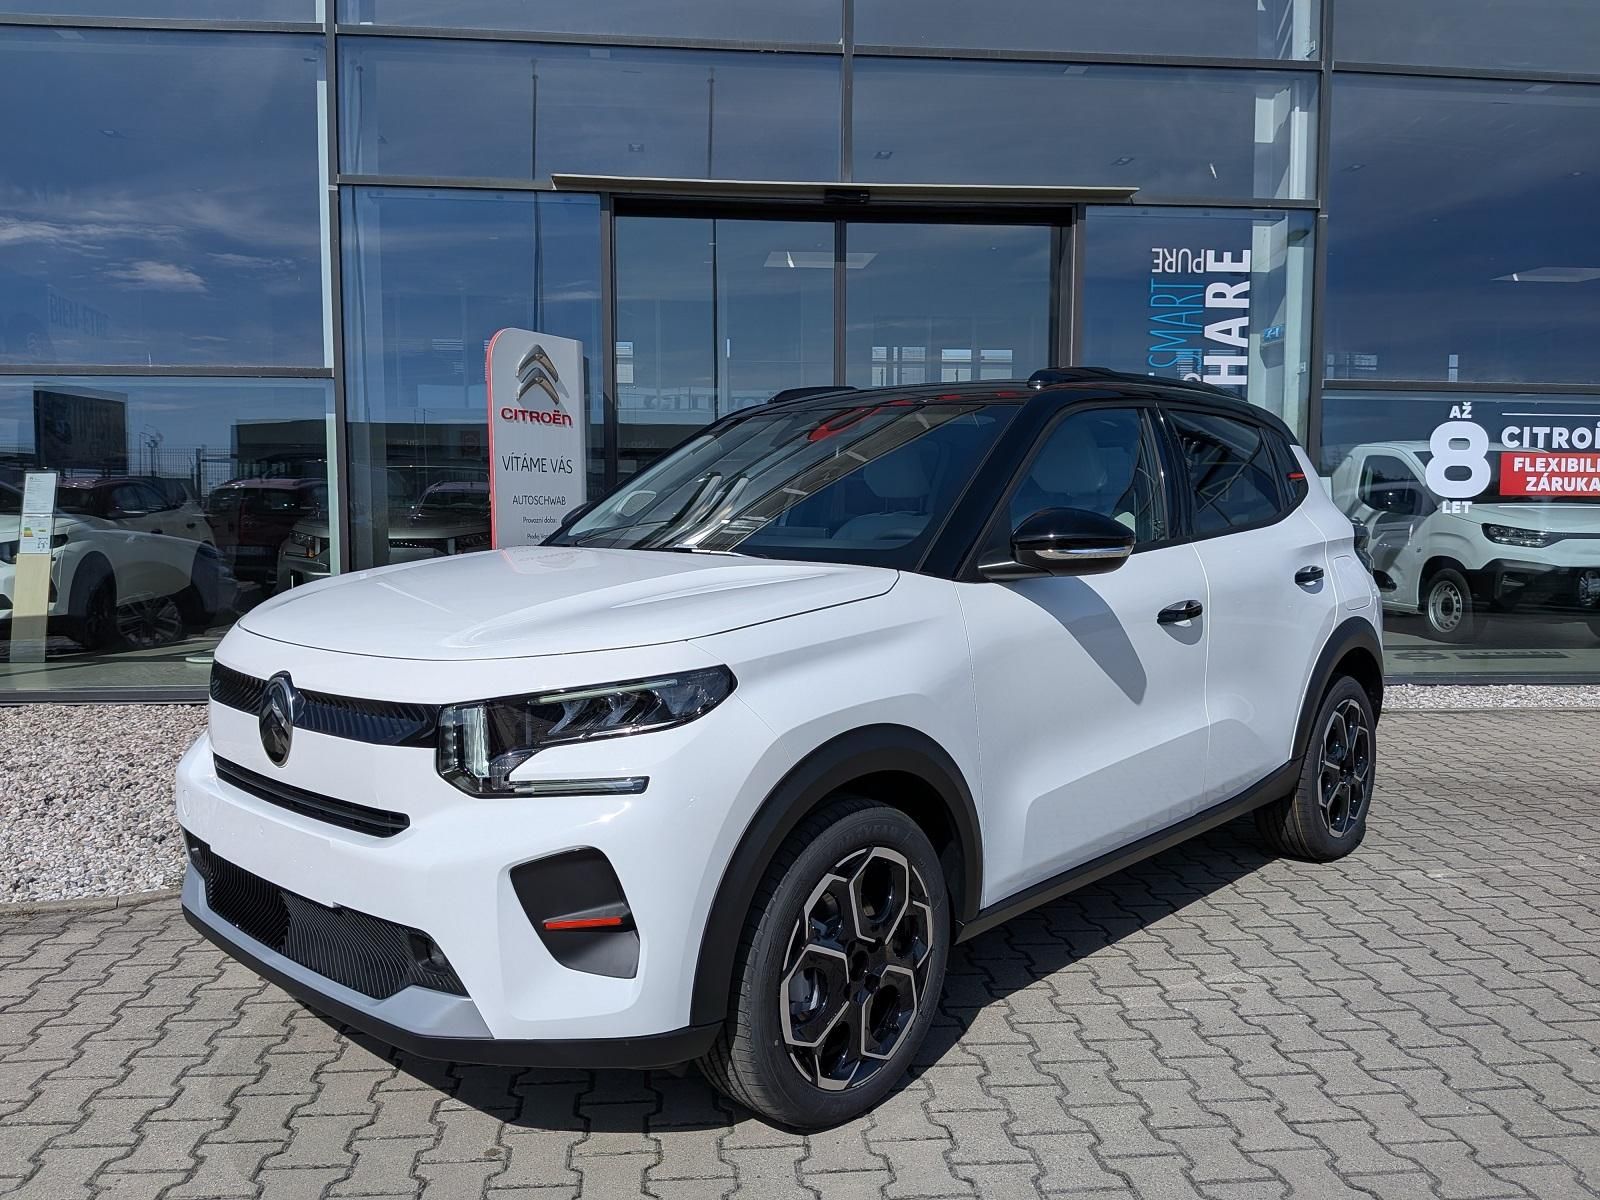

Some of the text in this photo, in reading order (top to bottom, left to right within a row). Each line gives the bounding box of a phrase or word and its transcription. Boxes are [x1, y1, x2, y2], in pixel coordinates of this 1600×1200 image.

[1151, 248, 1205, 274] PURE
[1149, 278, 1204, 369] SMART
[1449, 401, 1472, 419] AŽ
[501, 451, 573, 474] VÍTÁME VÁS
[1425, 421, 1491, 499] 8
[1525, 473, 1600, 492] ZÁRUKA
[512, 495, 567, 506] AUTOSCHWAB
[1442, 501, 1473, 514] LET
